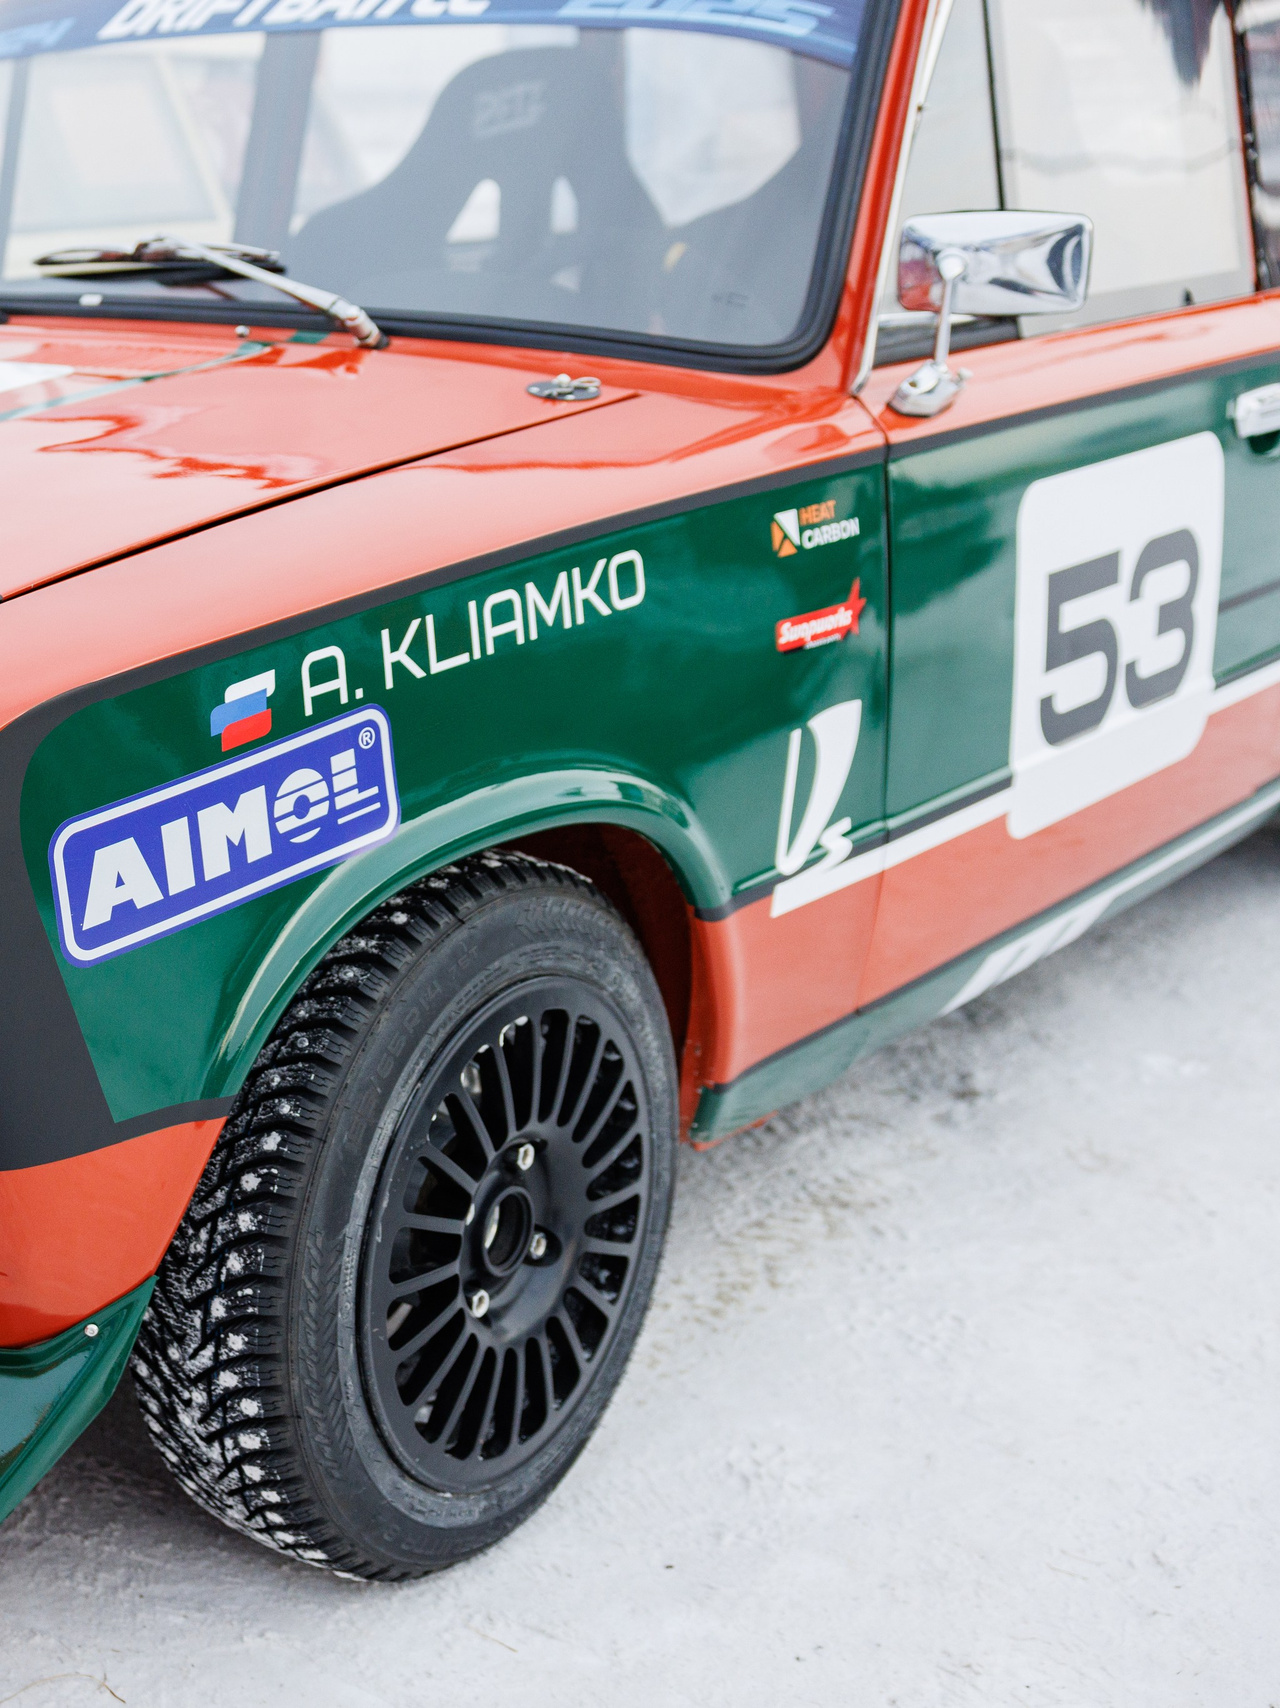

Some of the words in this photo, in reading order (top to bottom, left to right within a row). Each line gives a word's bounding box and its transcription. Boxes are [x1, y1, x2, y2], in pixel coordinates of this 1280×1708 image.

[799, 500, 836, 526] HEAT
[802, 517, 860, 549] CARBON
[300, 645, 364, 717] A.
[380, 549, 647, 690] KLIAMKO
[1039, 528, 1200, 748] 53
